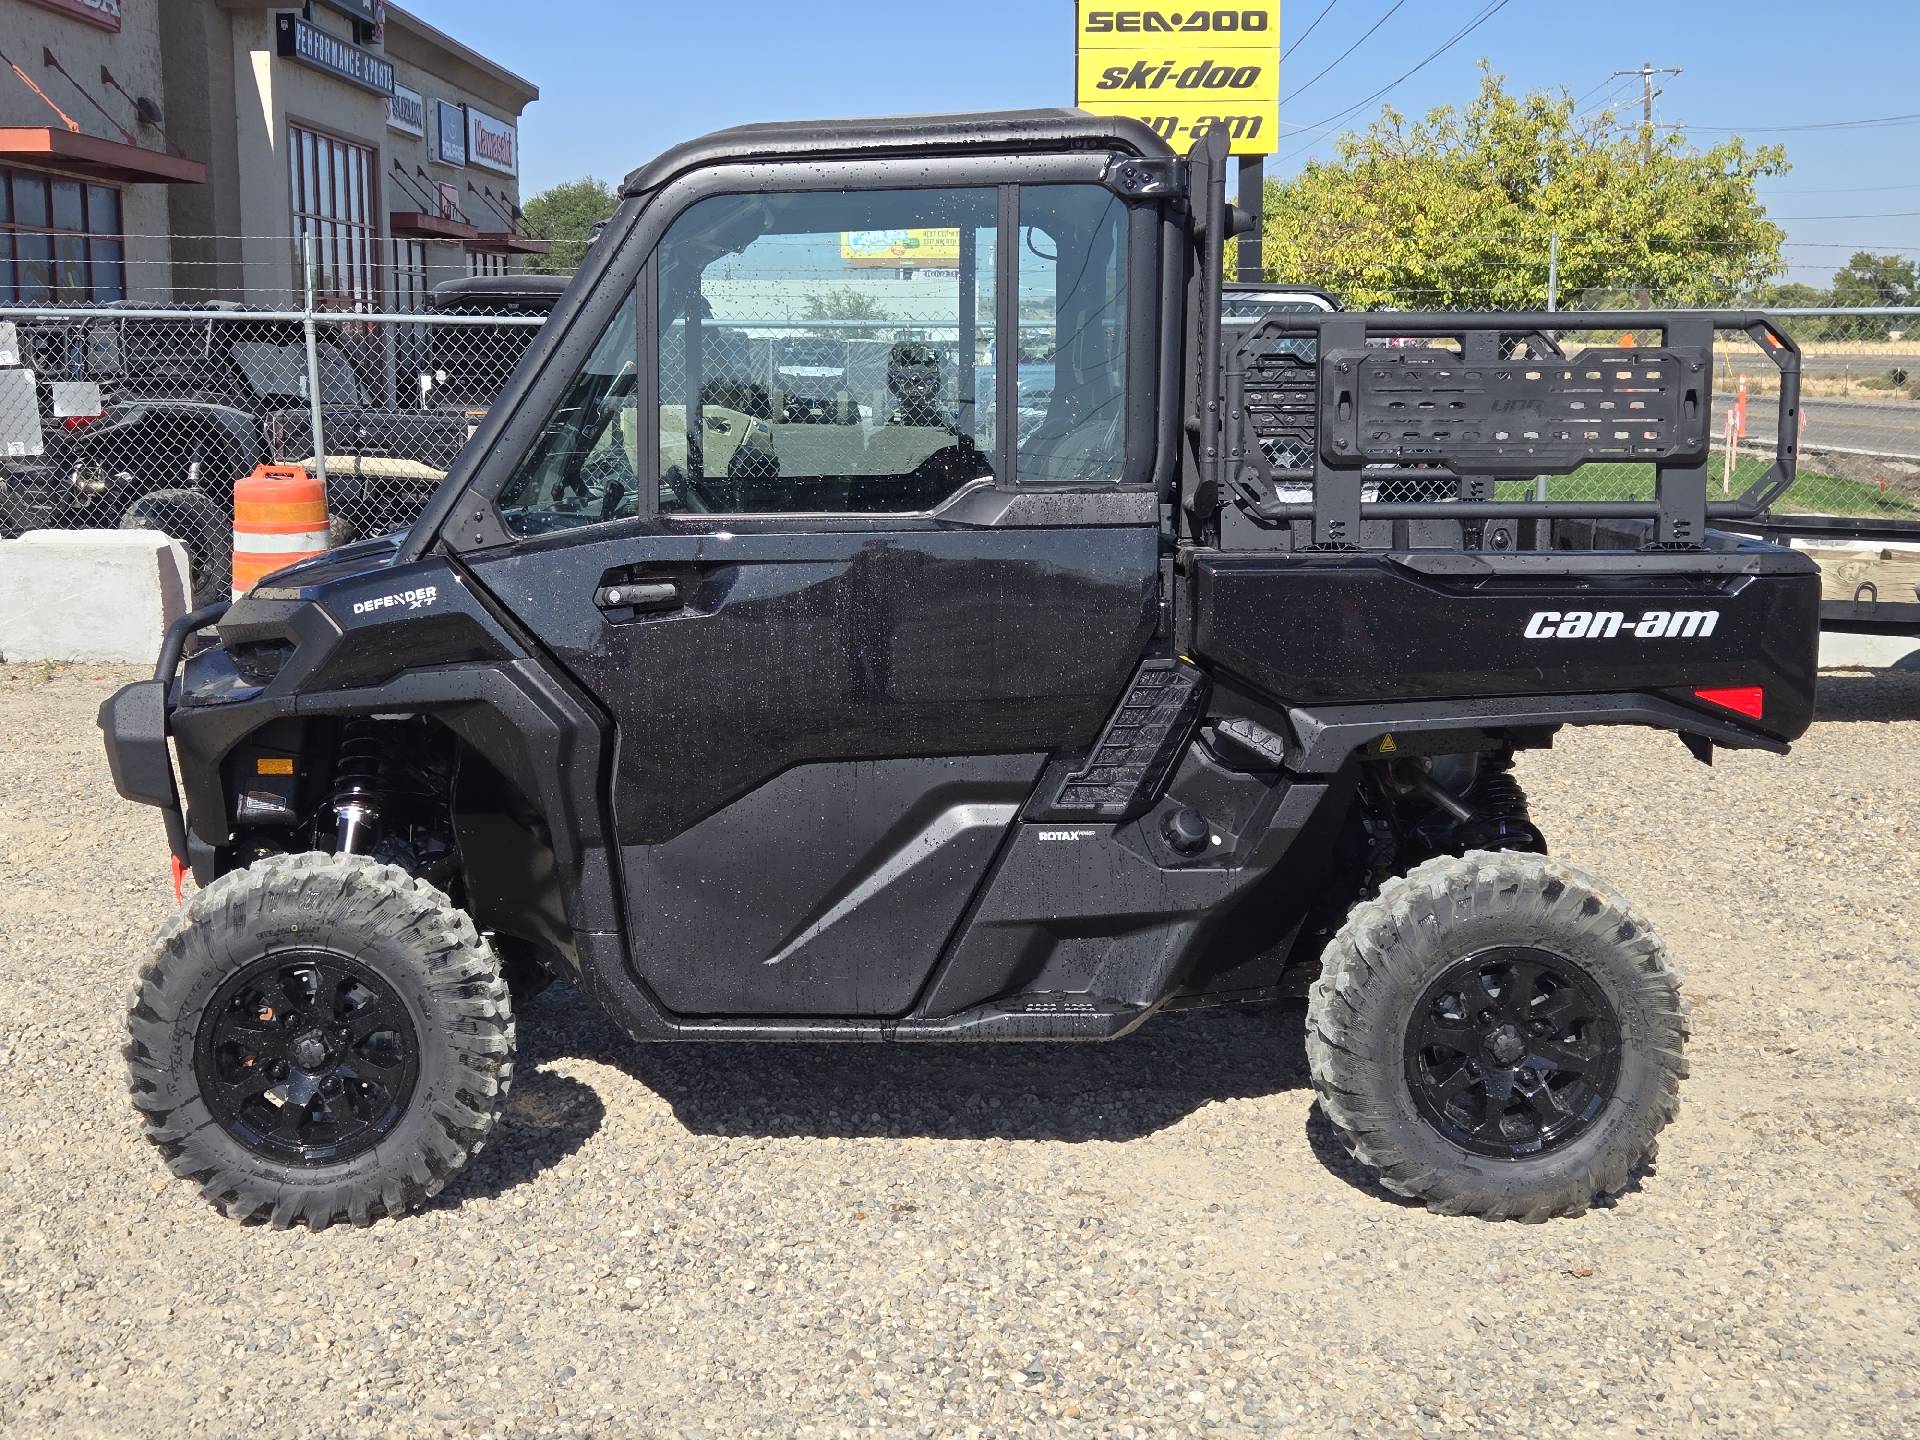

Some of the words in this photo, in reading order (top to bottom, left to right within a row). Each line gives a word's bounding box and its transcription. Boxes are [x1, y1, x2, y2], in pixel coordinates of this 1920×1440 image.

[296, 22, 361, 77] PERFORMANCE
[364, 55, 393, 90] SPORTS
[1095, 59, 1262, 90] ski-doo
[1140, 115, 1263, 140] n-am
[474, 119, 513, 168] Kawasaki
[353, 586, 436, 614] DEFENDER
[409, 597, 436, 610] XT
[1523, 611, 1720, 638] can-am
[1039, 831, 1079, 841] ROTAX
